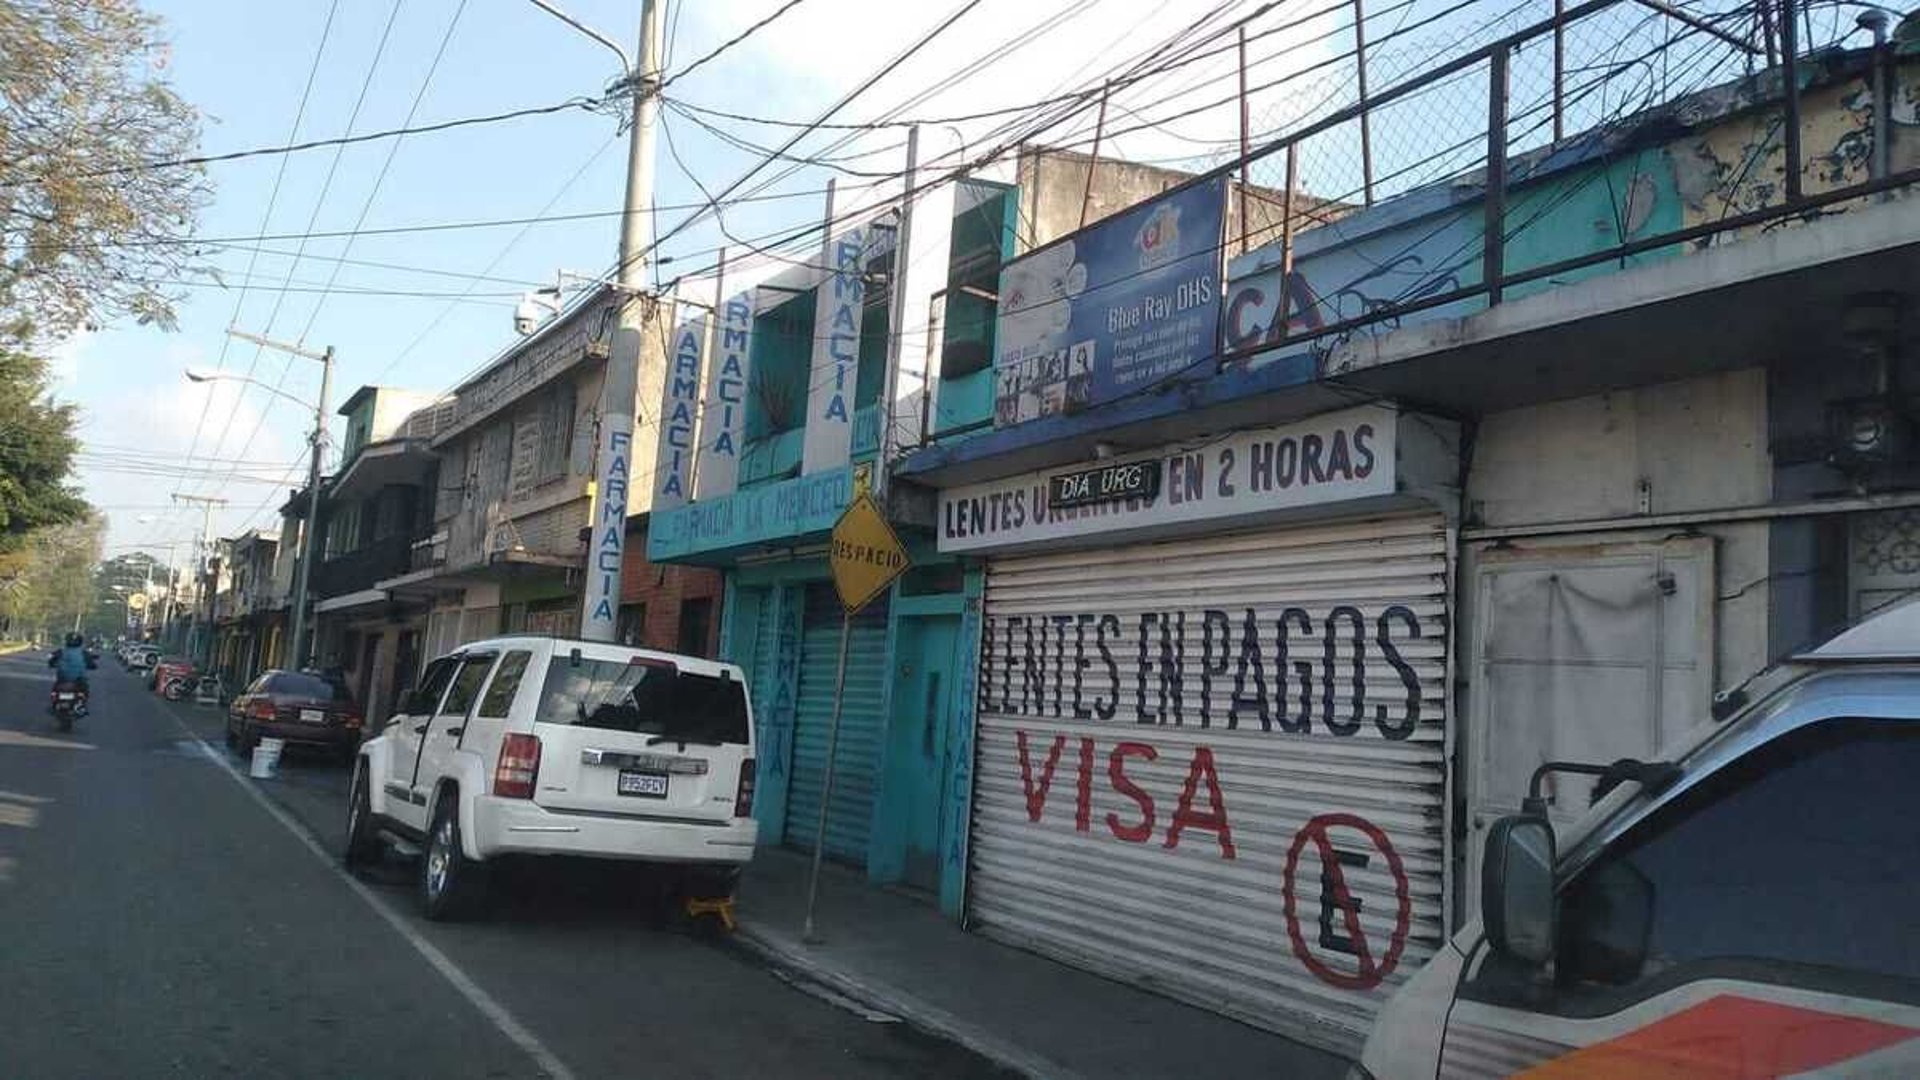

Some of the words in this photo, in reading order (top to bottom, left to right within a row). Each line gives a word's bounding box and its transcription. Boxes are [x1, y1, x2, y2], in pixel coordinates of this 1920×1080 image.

[1108, 306, 1139, 334] Blue
[1145, 295, 1172, 322] Ray
[1177, 275, 1212, 310] DHS
[593, 431, 631, 622] FARMACIA
[944, 489, 1026, 539] LENTES
[1168, 454, 1204, 506] EN
[1218, 448, 1236, 498] 2
[1250, 423, 1376, 492] HORAS
[1061, 473, 1090, 501] DIA
[981, 613, 1120, 721] LENTES
[1136, 610, 1186, 727] EN
[1200, 605, 1422, 741] PAGOS
[1017, 729, 1237, 860] VISA
